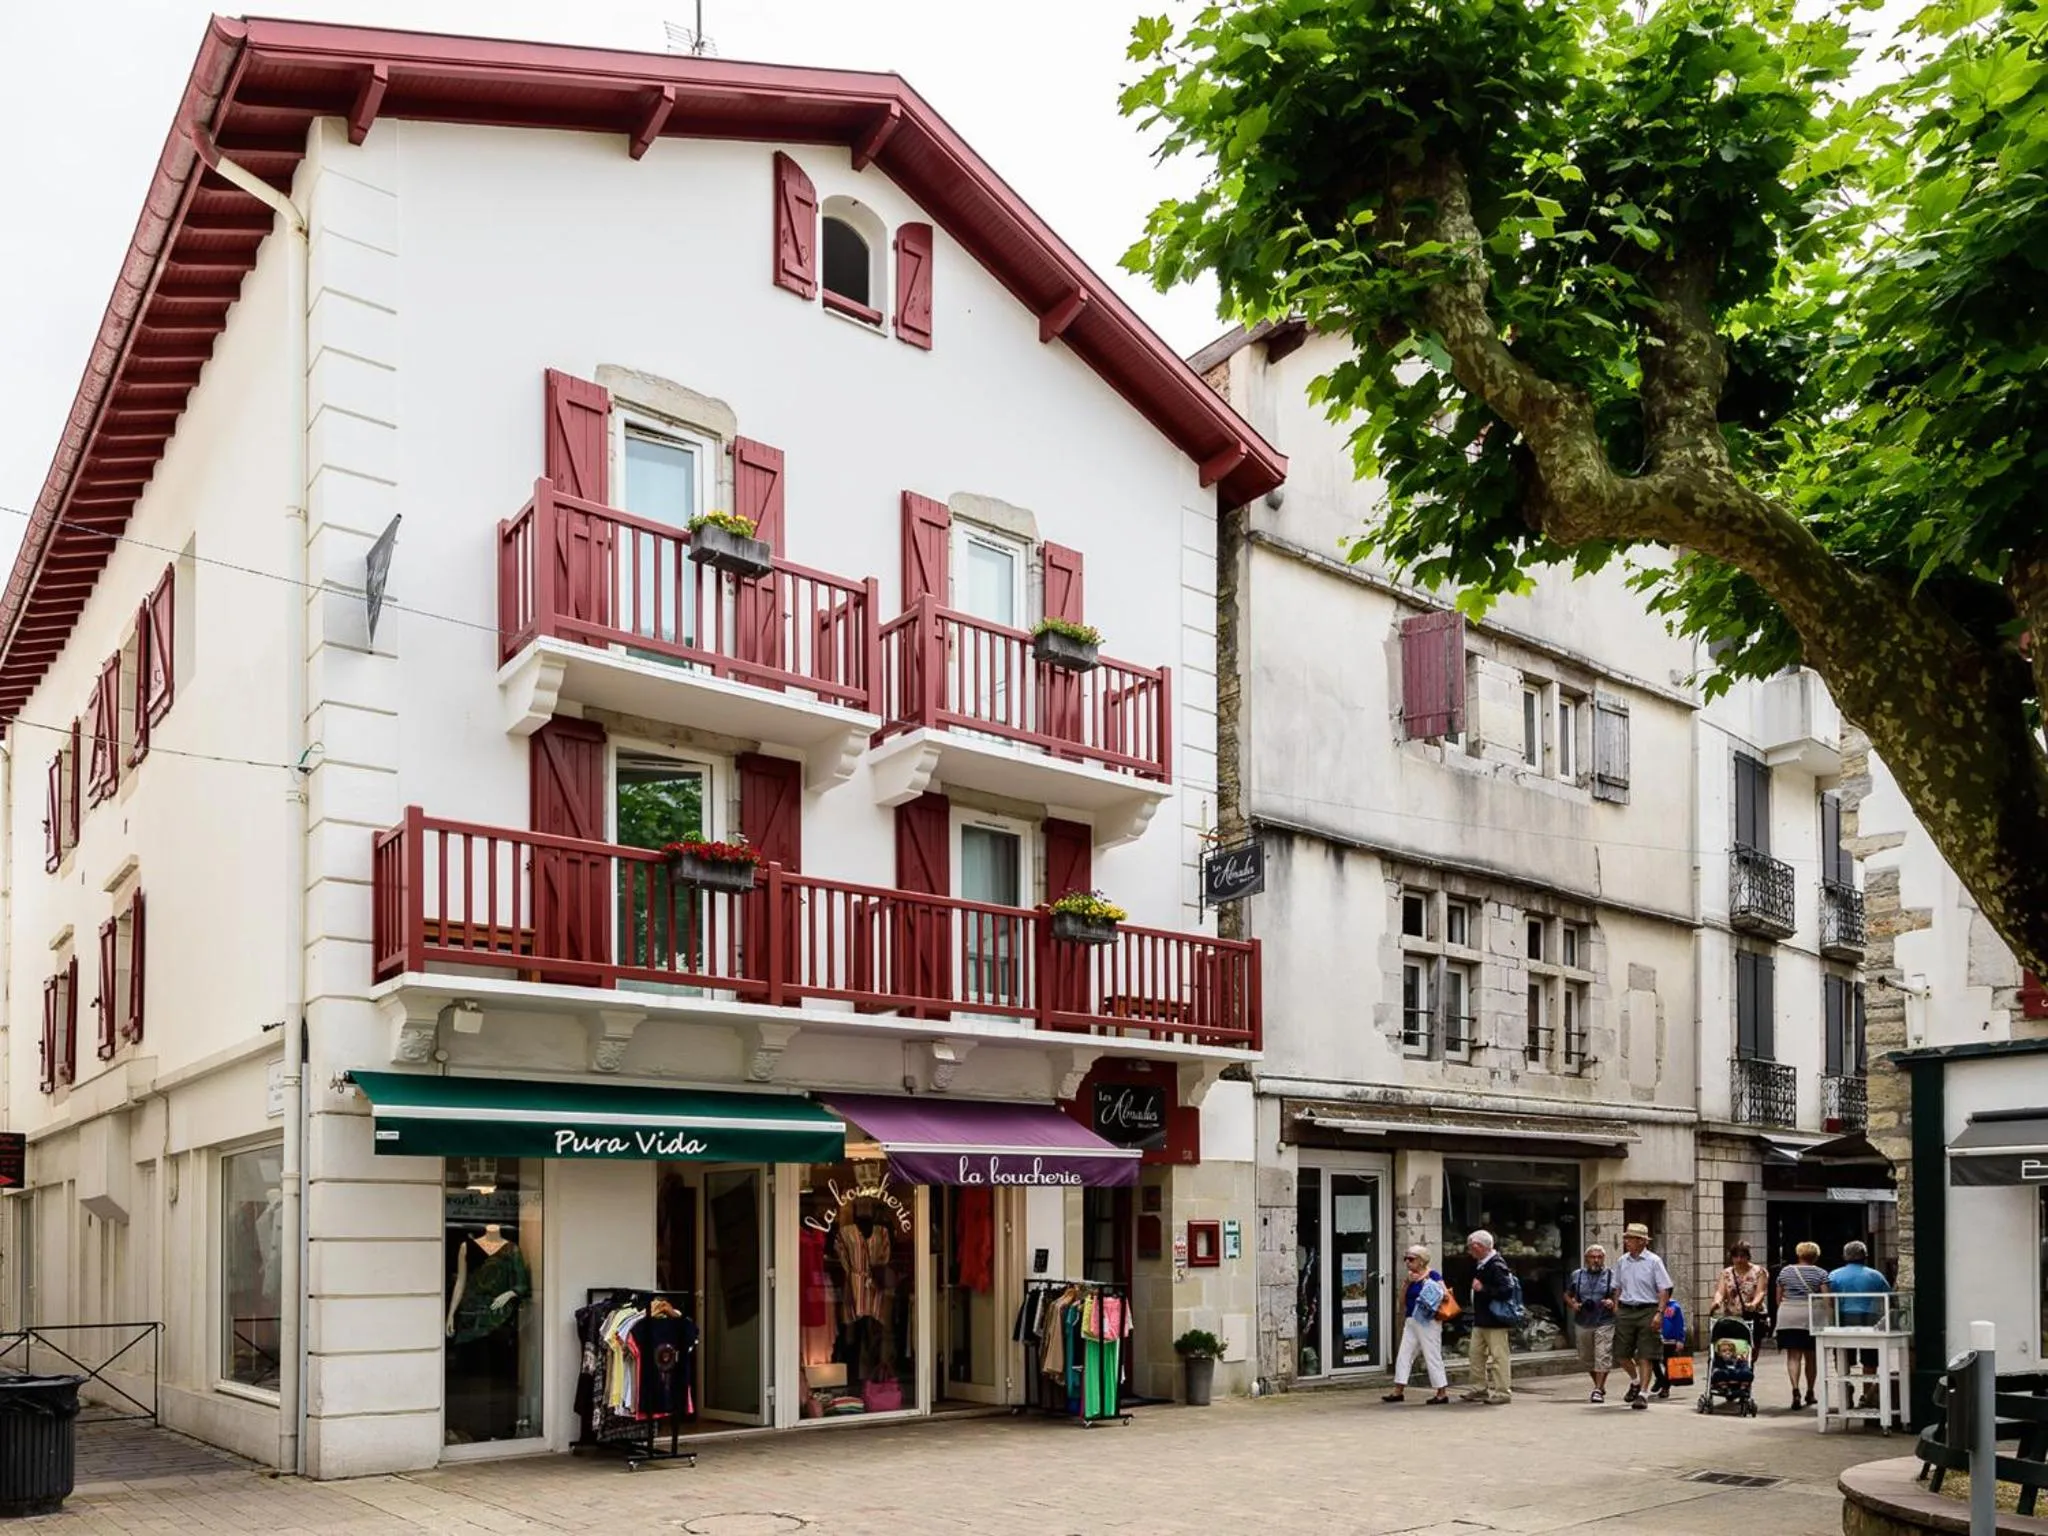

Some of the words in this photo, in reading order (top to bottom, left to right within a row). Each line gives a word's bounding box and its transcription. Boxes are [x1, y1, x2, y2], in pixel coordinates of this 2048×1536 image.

[555, 1130, 630, 1154] Pura
[635, 1131, 707, 1155] Vida
[959, 1155, 984, 1184] la
[990, 1156, 1082, 1185] boucherie
[804, 1208, 838, 1233] la
[827, 1171, 912, 1233] boucherie
